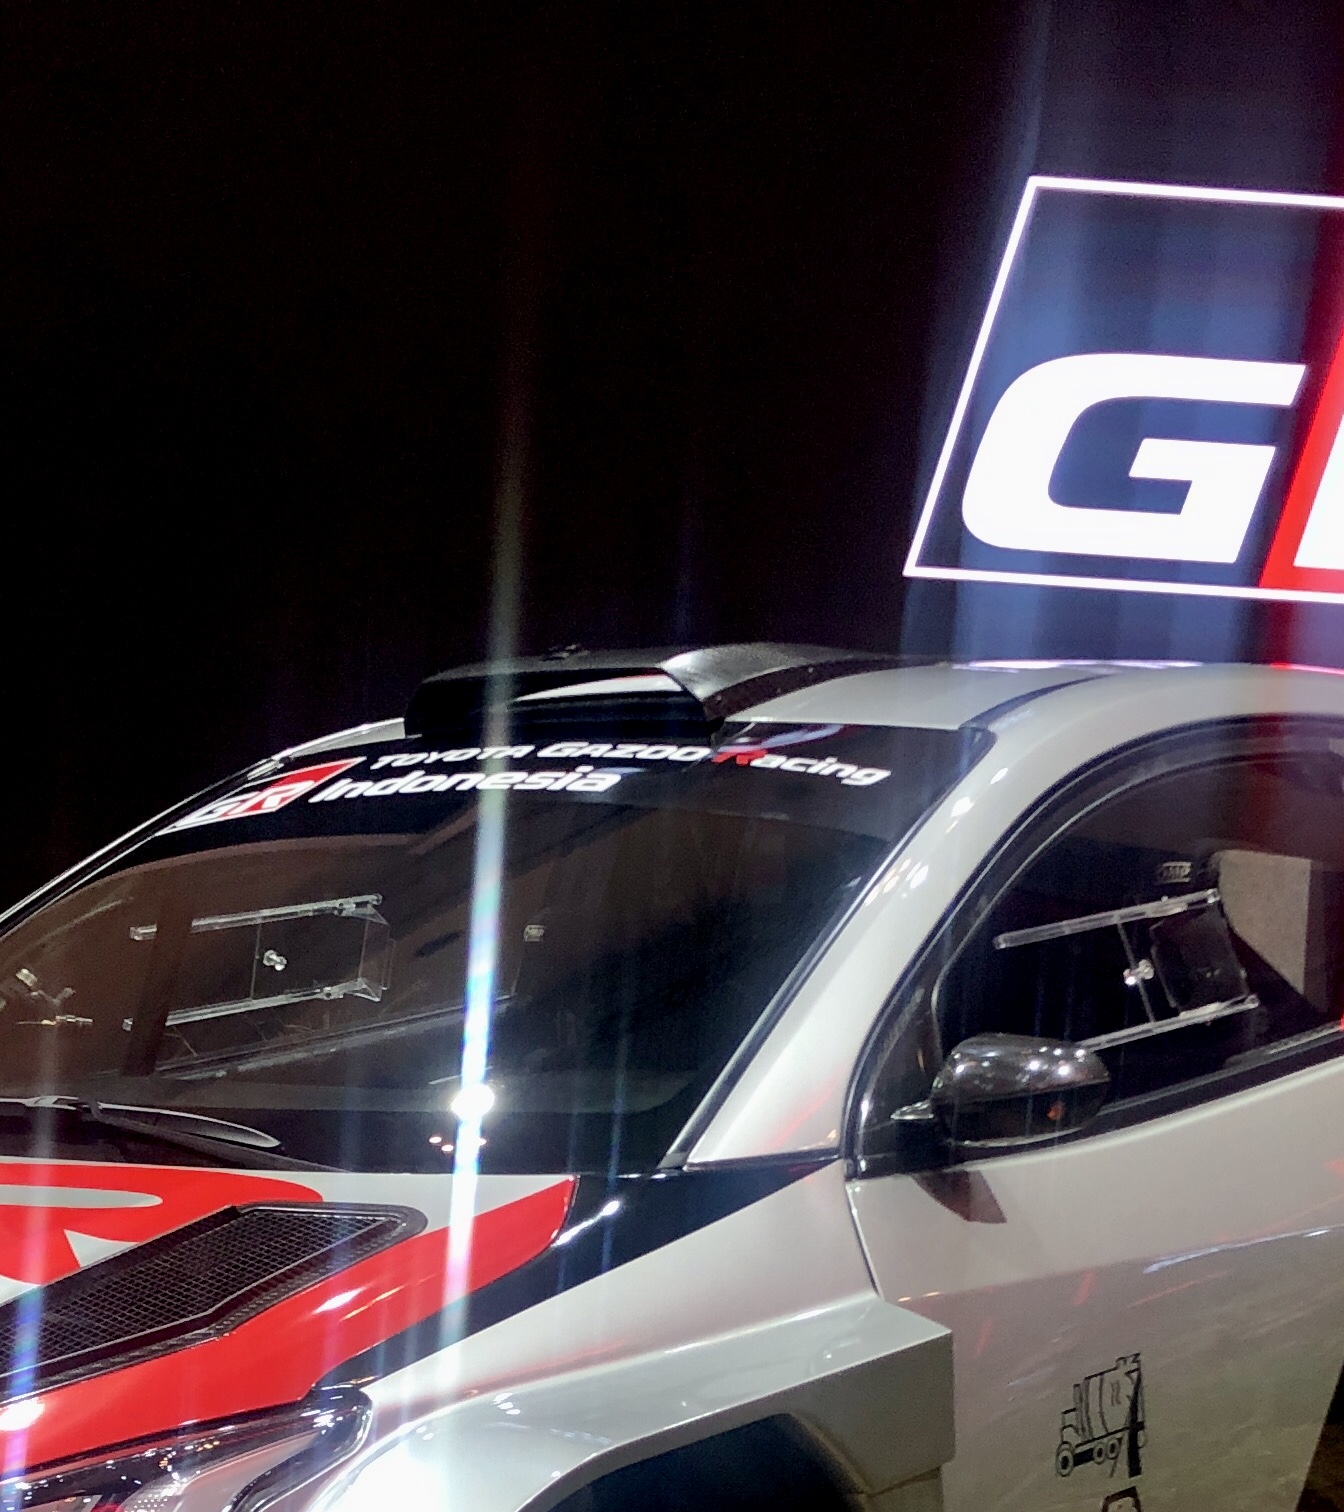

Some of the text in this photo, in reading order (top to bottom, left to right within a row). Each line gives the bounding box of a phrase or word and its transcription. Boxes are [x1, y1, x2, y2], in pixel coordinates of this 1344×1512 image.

[307, 765, 626, 803] Indonesia
[369, 740, 893, 786] TOYOTA GAZOO Racing
